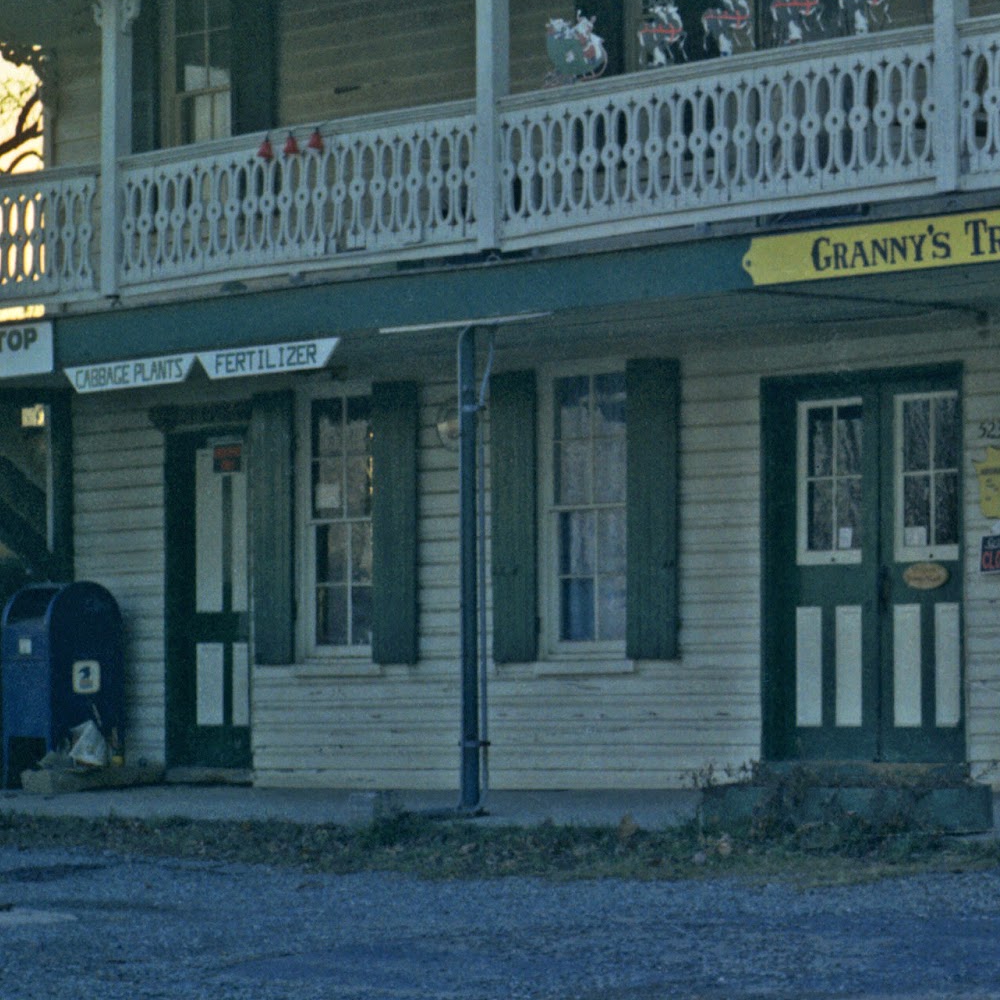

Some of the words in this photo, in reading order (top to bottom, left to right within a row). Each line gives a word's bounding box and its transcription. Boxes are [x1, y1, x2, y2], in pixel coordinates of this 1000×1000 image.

[811, 224, 951, 271] GRANNY'S
[75, 364, 130, 389] CABBAGE
[133, 357, 183, 383] PLANTS
[215, 343, 317, 374] FERTILIZER
